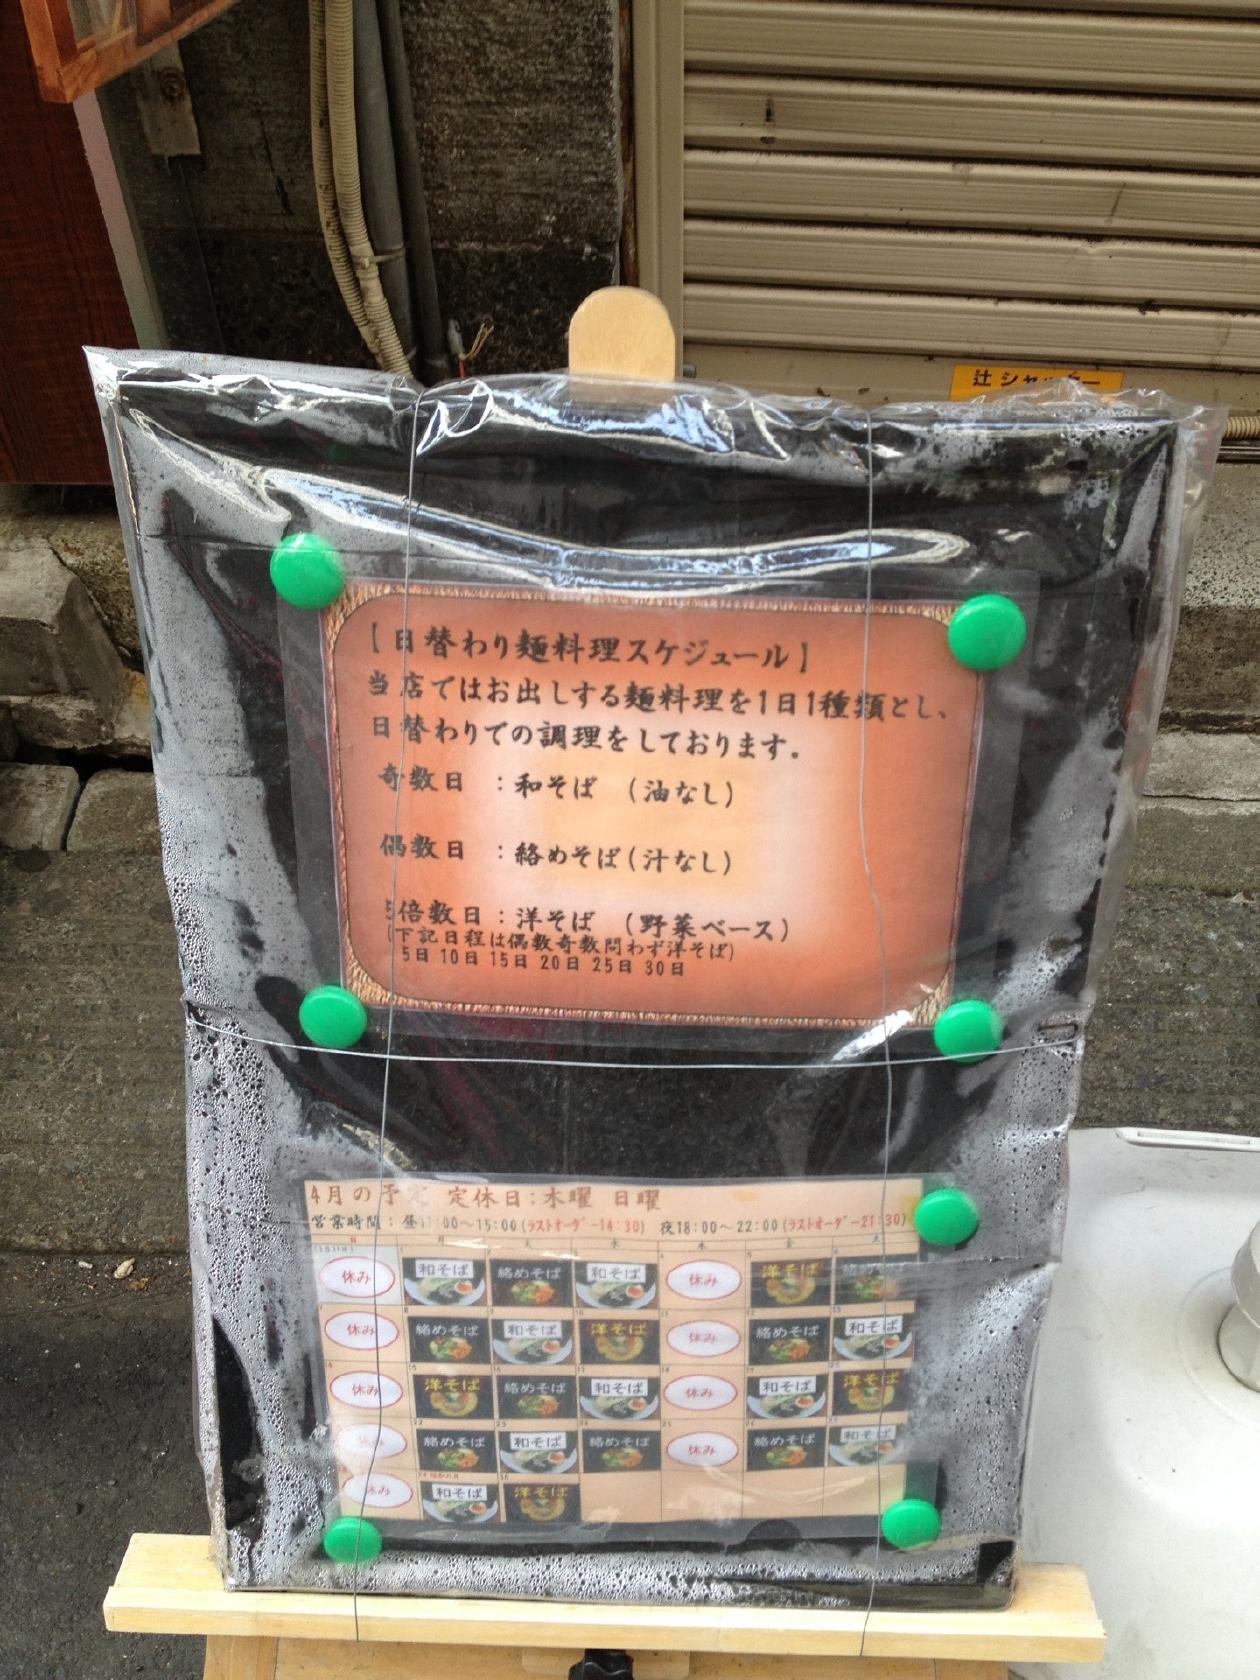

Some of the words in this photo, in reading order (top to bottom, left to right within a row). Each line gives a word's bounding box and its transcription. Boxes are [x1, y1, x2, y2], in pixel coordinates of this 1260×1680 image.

[973, 368, 1101, 387] 辻シャー
[373, 714, 800, 761] 日替わりでの調理をしております。
[379, 763, 463, 793] 奇数日
[380, 833, 464, 860] 偶数日
[310, 1183, 428, 1207] 4月の予
[614, 1188, 661, 1212] 日曜
[418, 1263, 469, 1277] 和そば
[497, 1267, 562, 1280] 絡めそば
[591, 1266, 641, 1279] 和そば
[761, 1263, 820, 1279] 洋そば
[342, 1269, 371, 1285] 休み
[689, 1273, 717, 1287] 休み
[346, 1324, 376, 1336] 休み
[415, 1324, 479, 1337] 絡めそば
[507, 1324, 557, 1337] 和そば
[590, 1323, 647, 1336] 洋そば
[755, 1325, 820, 1340] 絡めそば
[849, 1318, 899, 1335] 和そば
[689, 1332, 716, 1344] 休み
[424, 1378, 480, 1391] 洋そば
[762, 1379, 812, 1394] 和そば
[844, 1373, 898, 1388] 洋そば
[352, 1384, 380, 1397] 休み
[504, 1382, 567, 1394] 絡めそば
[593, 1382, 644, 1394] 和そば
[686, 1387, 714, 1399] 休み
[754, 1433, 815, 1448] 絡めそば
[844, 1427, 892, 1441] 和そば
[423, 1436, 486, 1448] 絡めそば
[514, 1436, 562, 1448] 和そば
[589, 1436, 650, 1448] 絡めそば
[688, 1444, 716, 1456] 休み
[437, 1487, 483, 1499] 和そば
[514, 1486, 568, 1499] 洋そば
